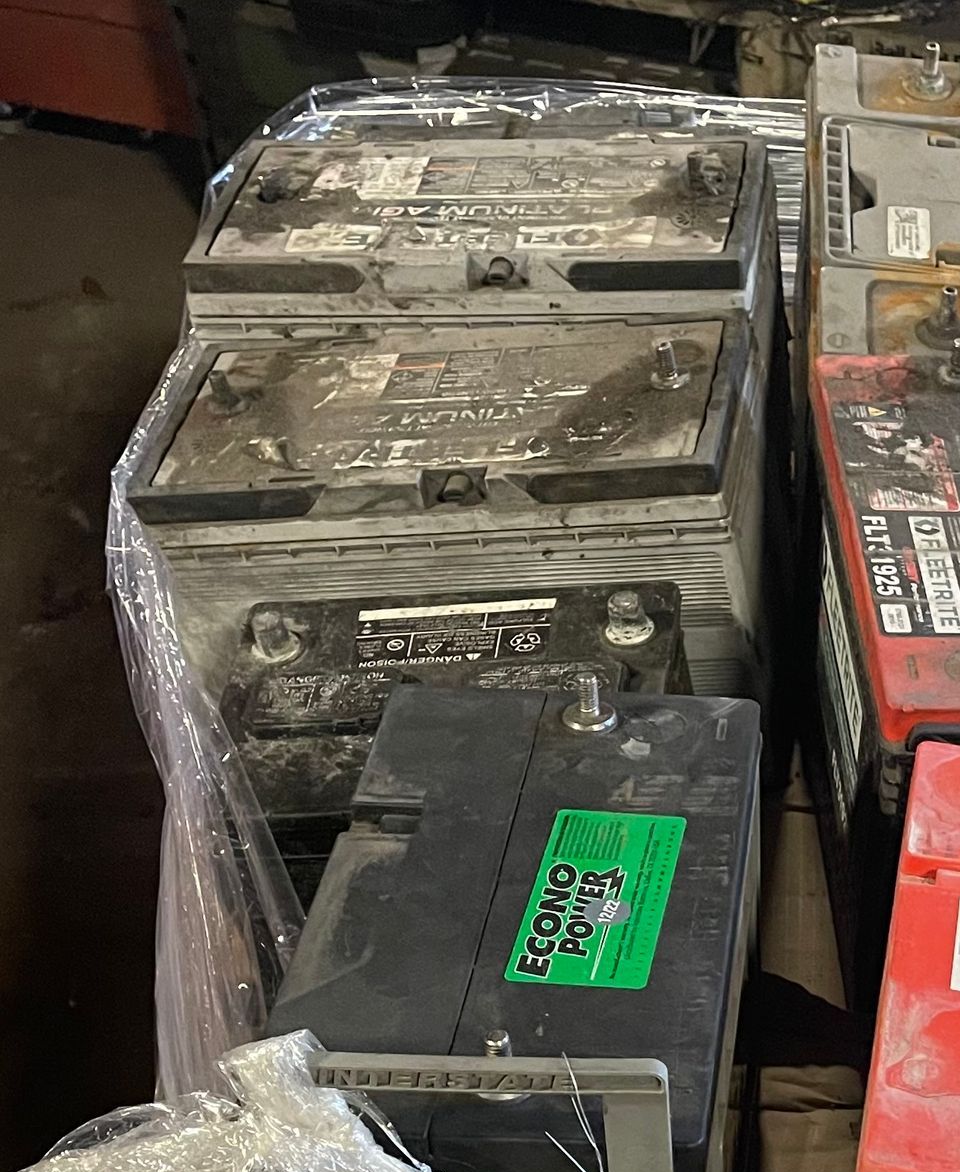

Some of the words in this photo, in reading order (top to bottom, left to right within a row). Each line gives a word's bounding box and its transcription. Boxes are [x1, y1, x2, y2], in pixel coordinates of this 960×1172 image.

[860, 513, 901, 598] FLT31925
[921, 536, 960, 631] FLEETRITE
[516, 857, 579, 978] ECONO
[557, 866, 612, 959] POWER
[597, 897, 621, 925] 12/22
[313, 1067, 574, 1091] INTERSTATE
